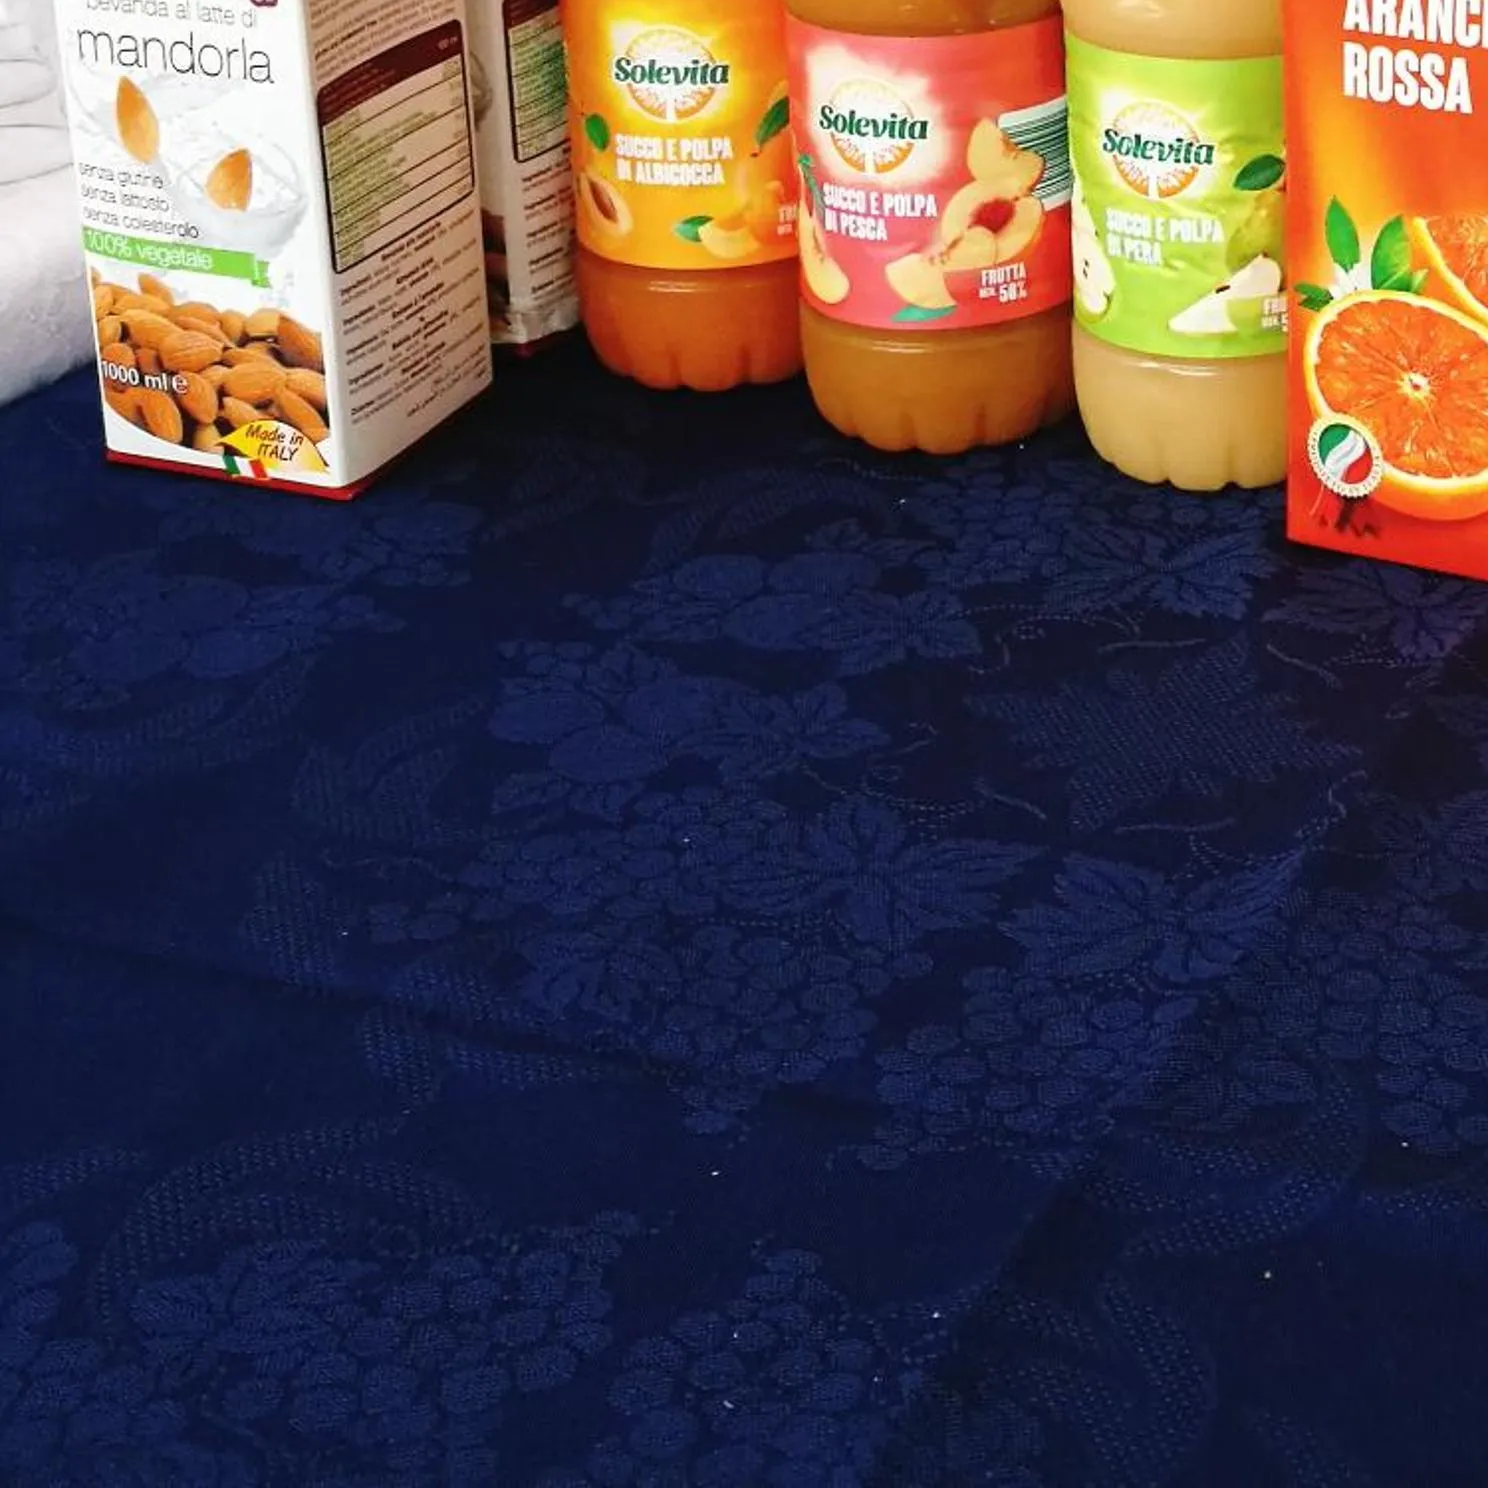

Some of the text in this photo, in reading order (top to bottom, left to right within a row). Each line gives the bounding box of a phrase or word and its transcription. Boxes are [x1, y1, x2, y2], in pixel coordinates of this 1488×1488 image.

[197, 1, 235, 25] latte
[241, 8, 257, 28] di
[77, 30, 274, 84] mandorla
[614, 57, 730, 85] Solevita
[1343, 41, 1473, 114] ROSSA
[819, 105, 928, 140] Solevita
[615, 134, 733, 161] SUCCO E POLPA
[1103, 128, 1215, 165] Solevita
[823, 183, 937, 217] SUCCO E POLPA
[841, 215, 887, 241] PESCA
[1155, 217, 1165, 239] E
[1169, 218, 1223, 243] POLPA
[87, 230, 213, 270] 100% vegetale
[102, 360, 140, 386] 1000
[145, 373, 168, 391] ml
[245, 424, 304, 447] Made in
[257, 443, 299, 462] ITALY
